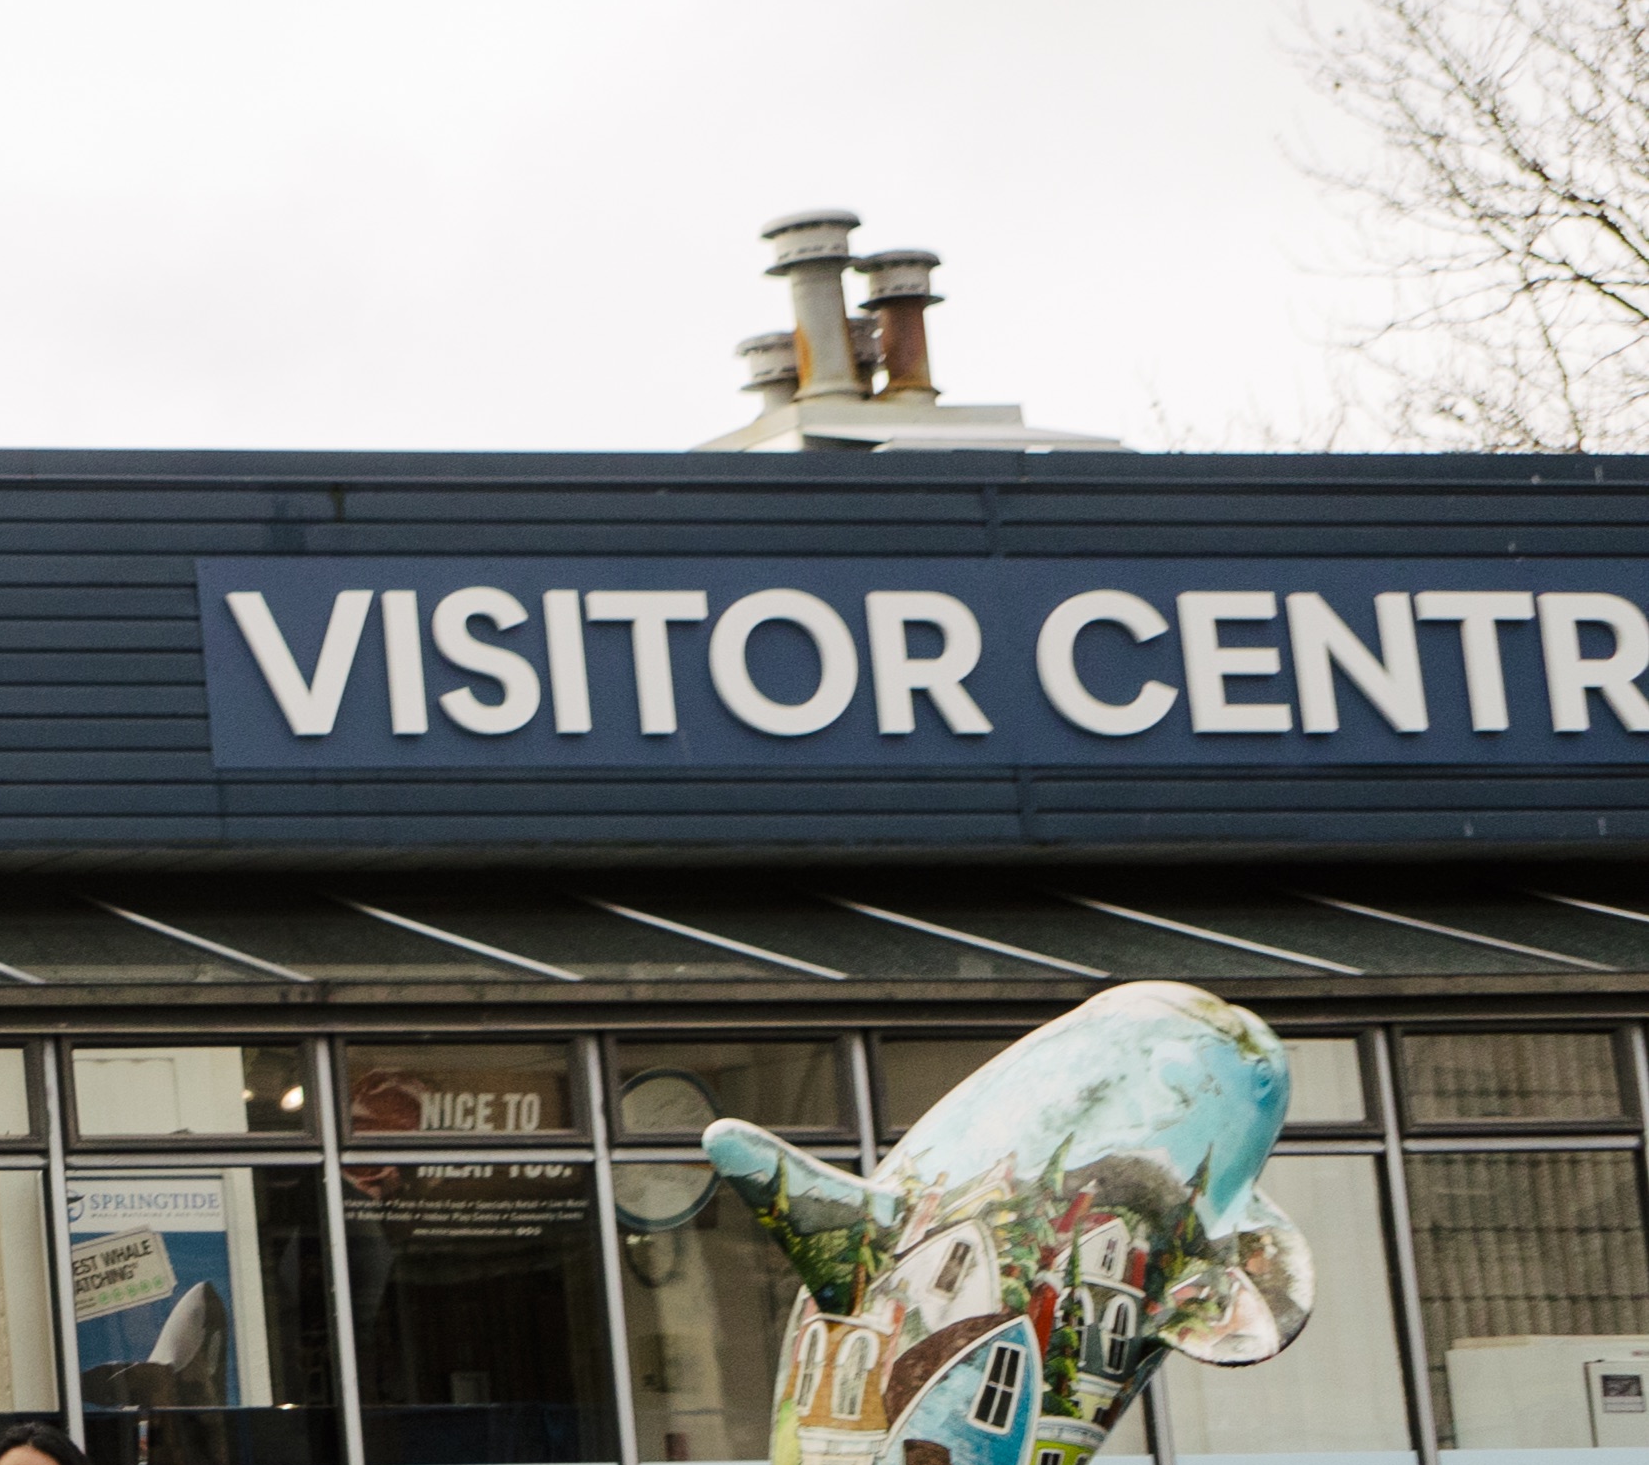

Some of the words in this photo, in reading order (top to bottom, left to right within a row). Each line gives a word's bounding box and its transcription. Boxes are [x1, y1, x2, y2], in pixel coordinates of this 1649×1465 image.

[225, 586, 993, 737] VISITOR
[420, 1091, 495, 1131] NICE
[502, 1091, 541, 1131] TO
[90, 1192, 219, 1210] SPRINGTIDE
[101, 1239, 153, 1267] WHALE
